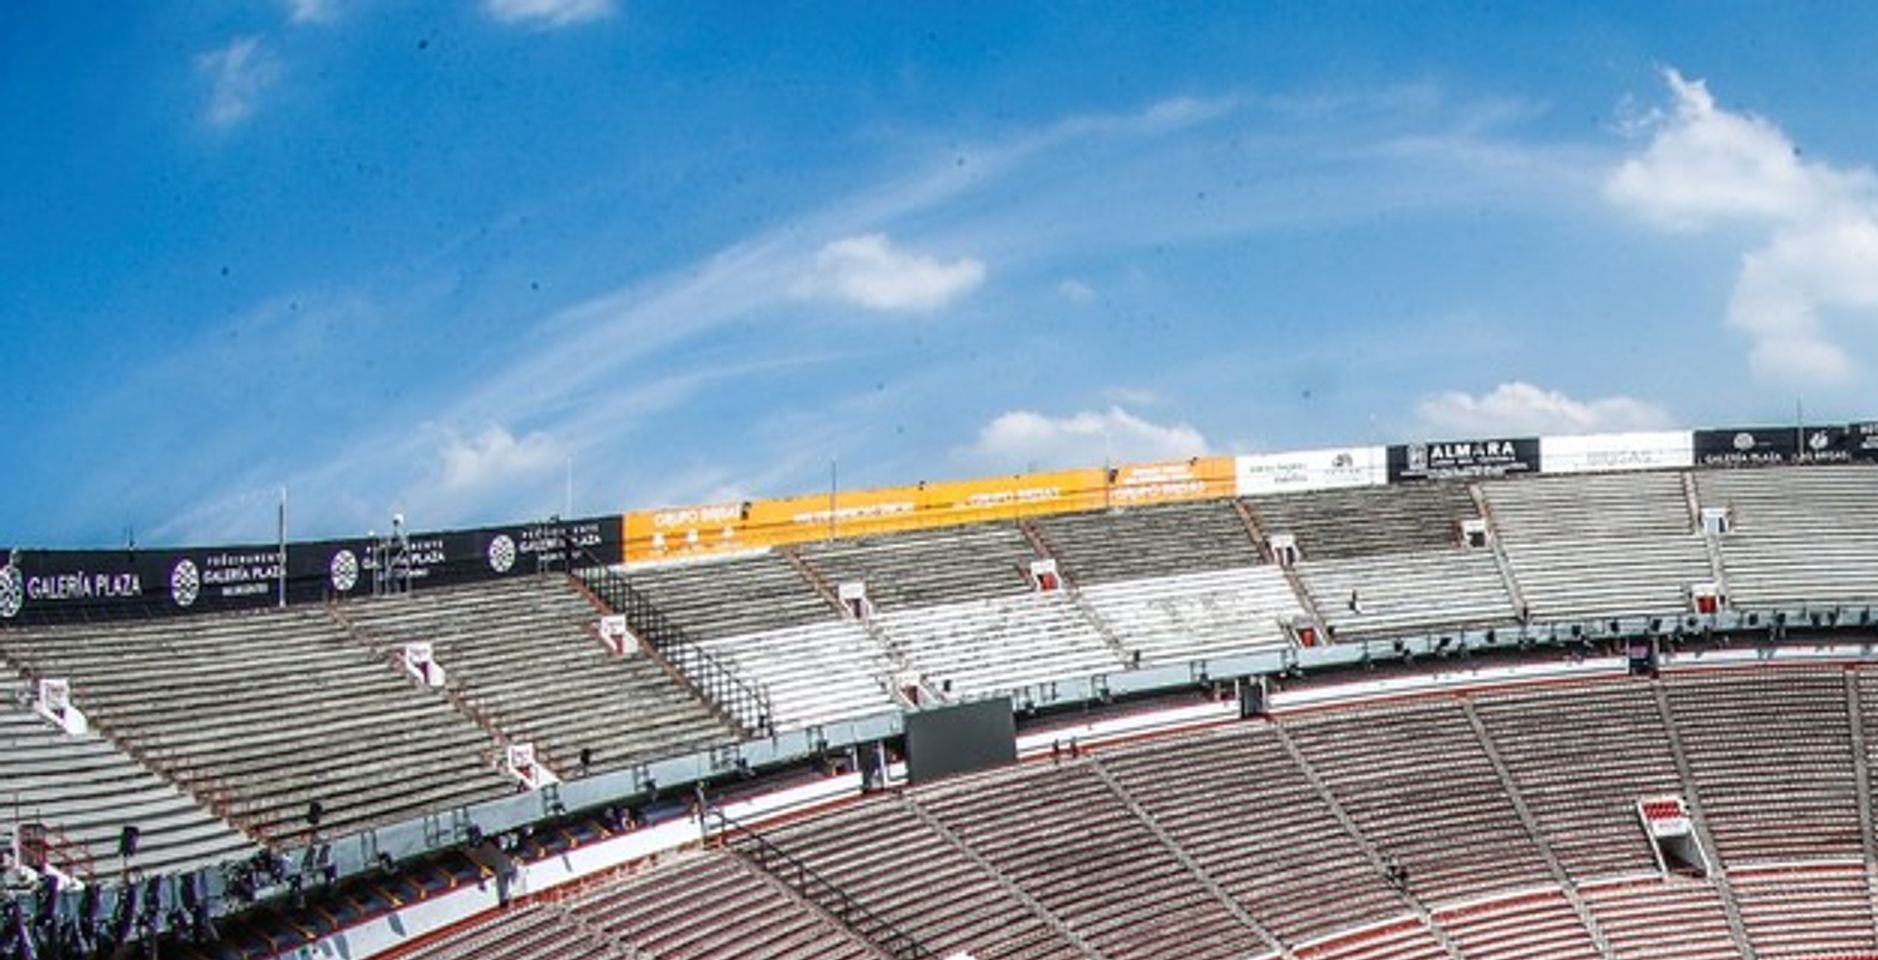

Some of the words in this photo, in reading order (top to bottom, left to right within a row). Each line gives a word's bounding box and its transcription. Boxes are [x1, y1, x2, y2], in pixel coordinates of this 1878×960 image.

[1430, 441, 1516, 459] ALMARA
[202, 565, 250, 584] GALERÍA
[27, 570, 92, 600] GALERÍA
[95, 572, 142, 597] PLAZA
